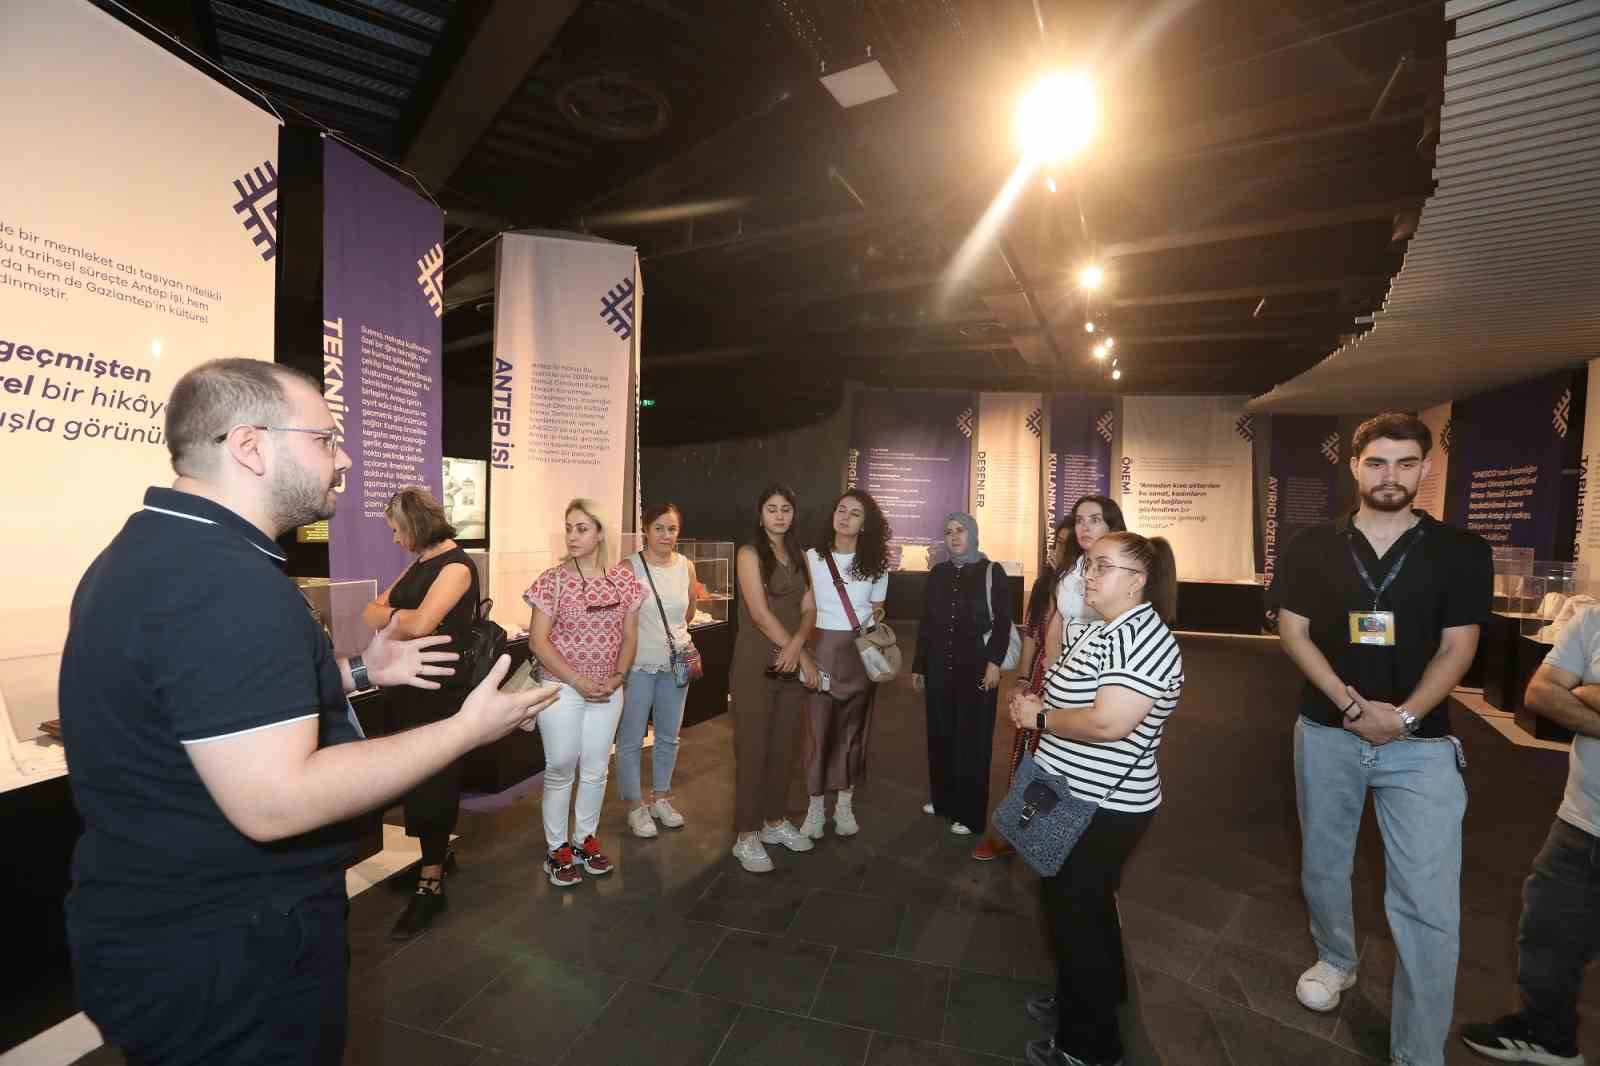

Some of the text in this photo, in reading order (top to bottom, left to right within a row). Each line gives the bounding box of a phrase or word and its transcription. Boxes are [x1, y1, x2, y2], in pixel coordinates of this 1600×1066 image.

[19, 226, 40, 243] bir
[44, 239, 113, 268] memleket
[116, 262, 137, 275] adı
[140, 268, 184, 290] taşıyan
[19, 246, 76, 271] tarihsel
[79, 264, 129, 288] süreçte
[131, 280, 167, 299] Antep
[187, 296, 209, 311] hem
[27, 263, 61, 283] hem
[64, 275, 82, 289] de
[168, 303, 209, 324] kültürel
[0, 339, 152, 384] geçmişten
[41, 377, 85, 403] bir
[91, 386, 168, 420] hikây
[492, 357, 513, 437] ANTEP
[63, 417, 167, 446] görünü
[976, 451, 986, 508] DESENLER
[1048, 453, 1057, 511] KULLANIM
